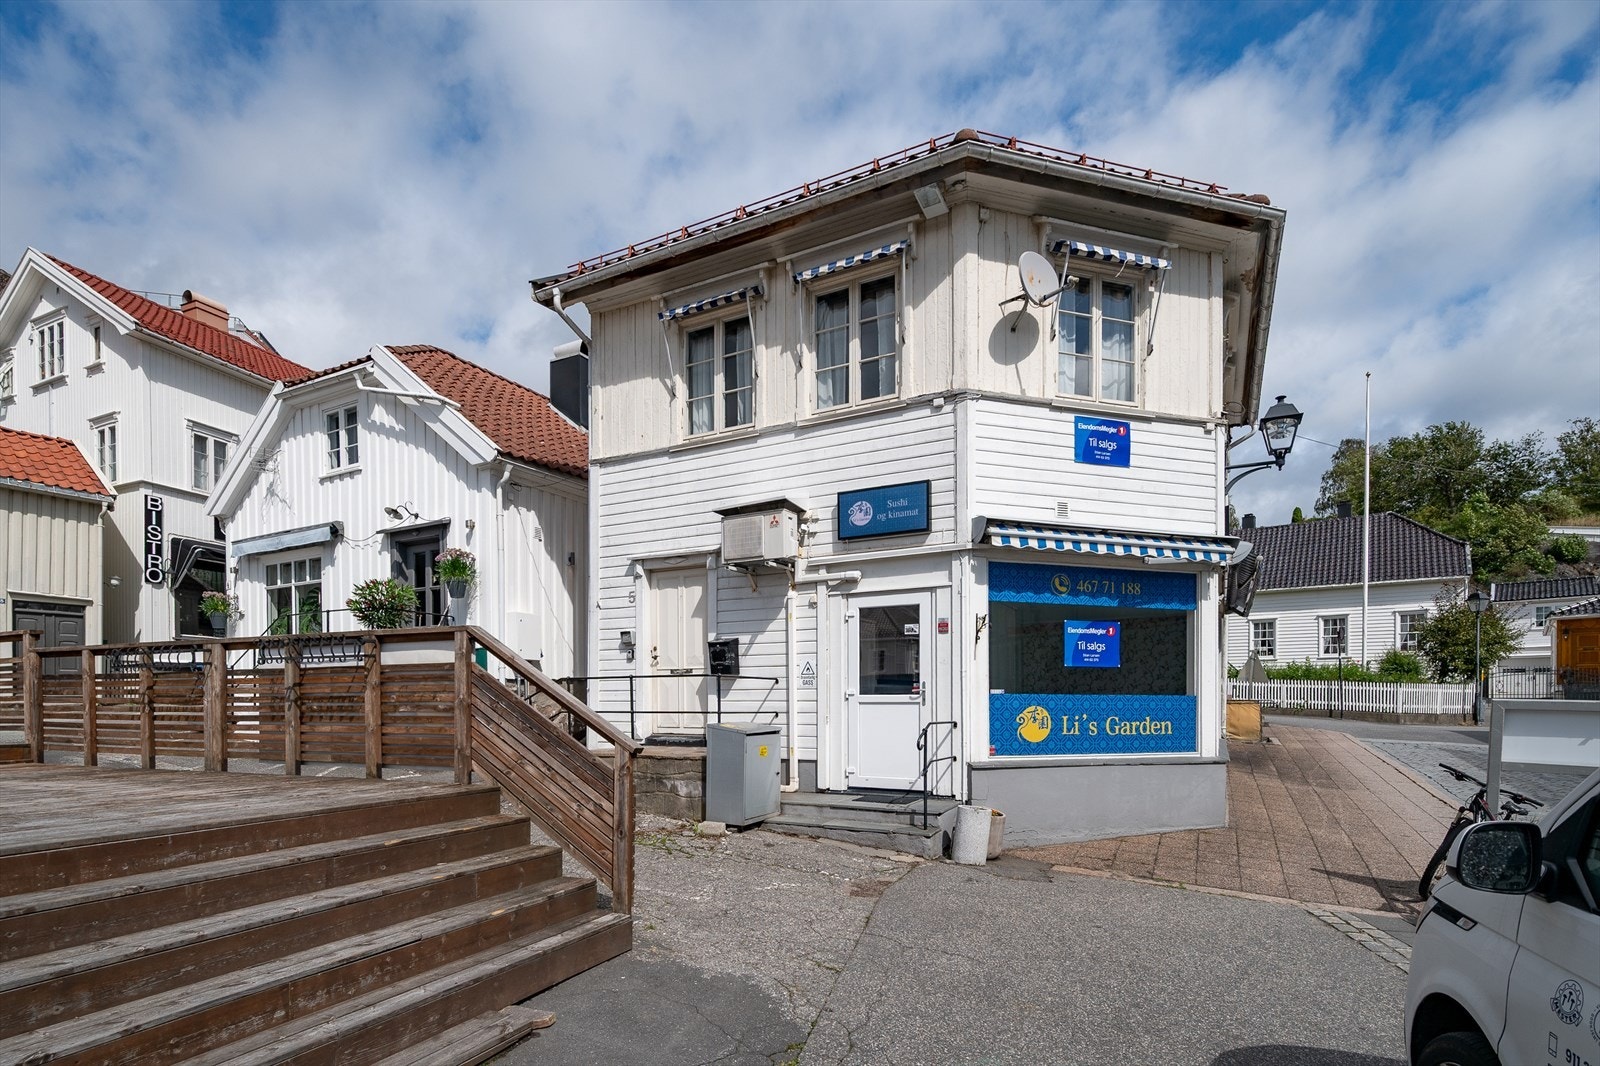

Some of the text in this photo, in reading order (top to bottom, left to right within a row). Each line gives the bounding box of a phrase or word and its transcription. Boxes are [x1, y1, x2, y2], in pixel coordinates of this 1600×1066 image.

[1088, 437, 1117, 451] Til salgs
[887, 498, 908, 508] Sushi
[876, 512, 887, 522] og
[888, 508, 919, 519] kinamat
[146, 495, 163, 583] BISTRO
[1076, 579, 1141, 595] 467 71 188
[628, 590, 636, 604] 5
[1077, 641, 1106, 652] Til salgs
[1061, 713, 1173, 736] Li's Garden
